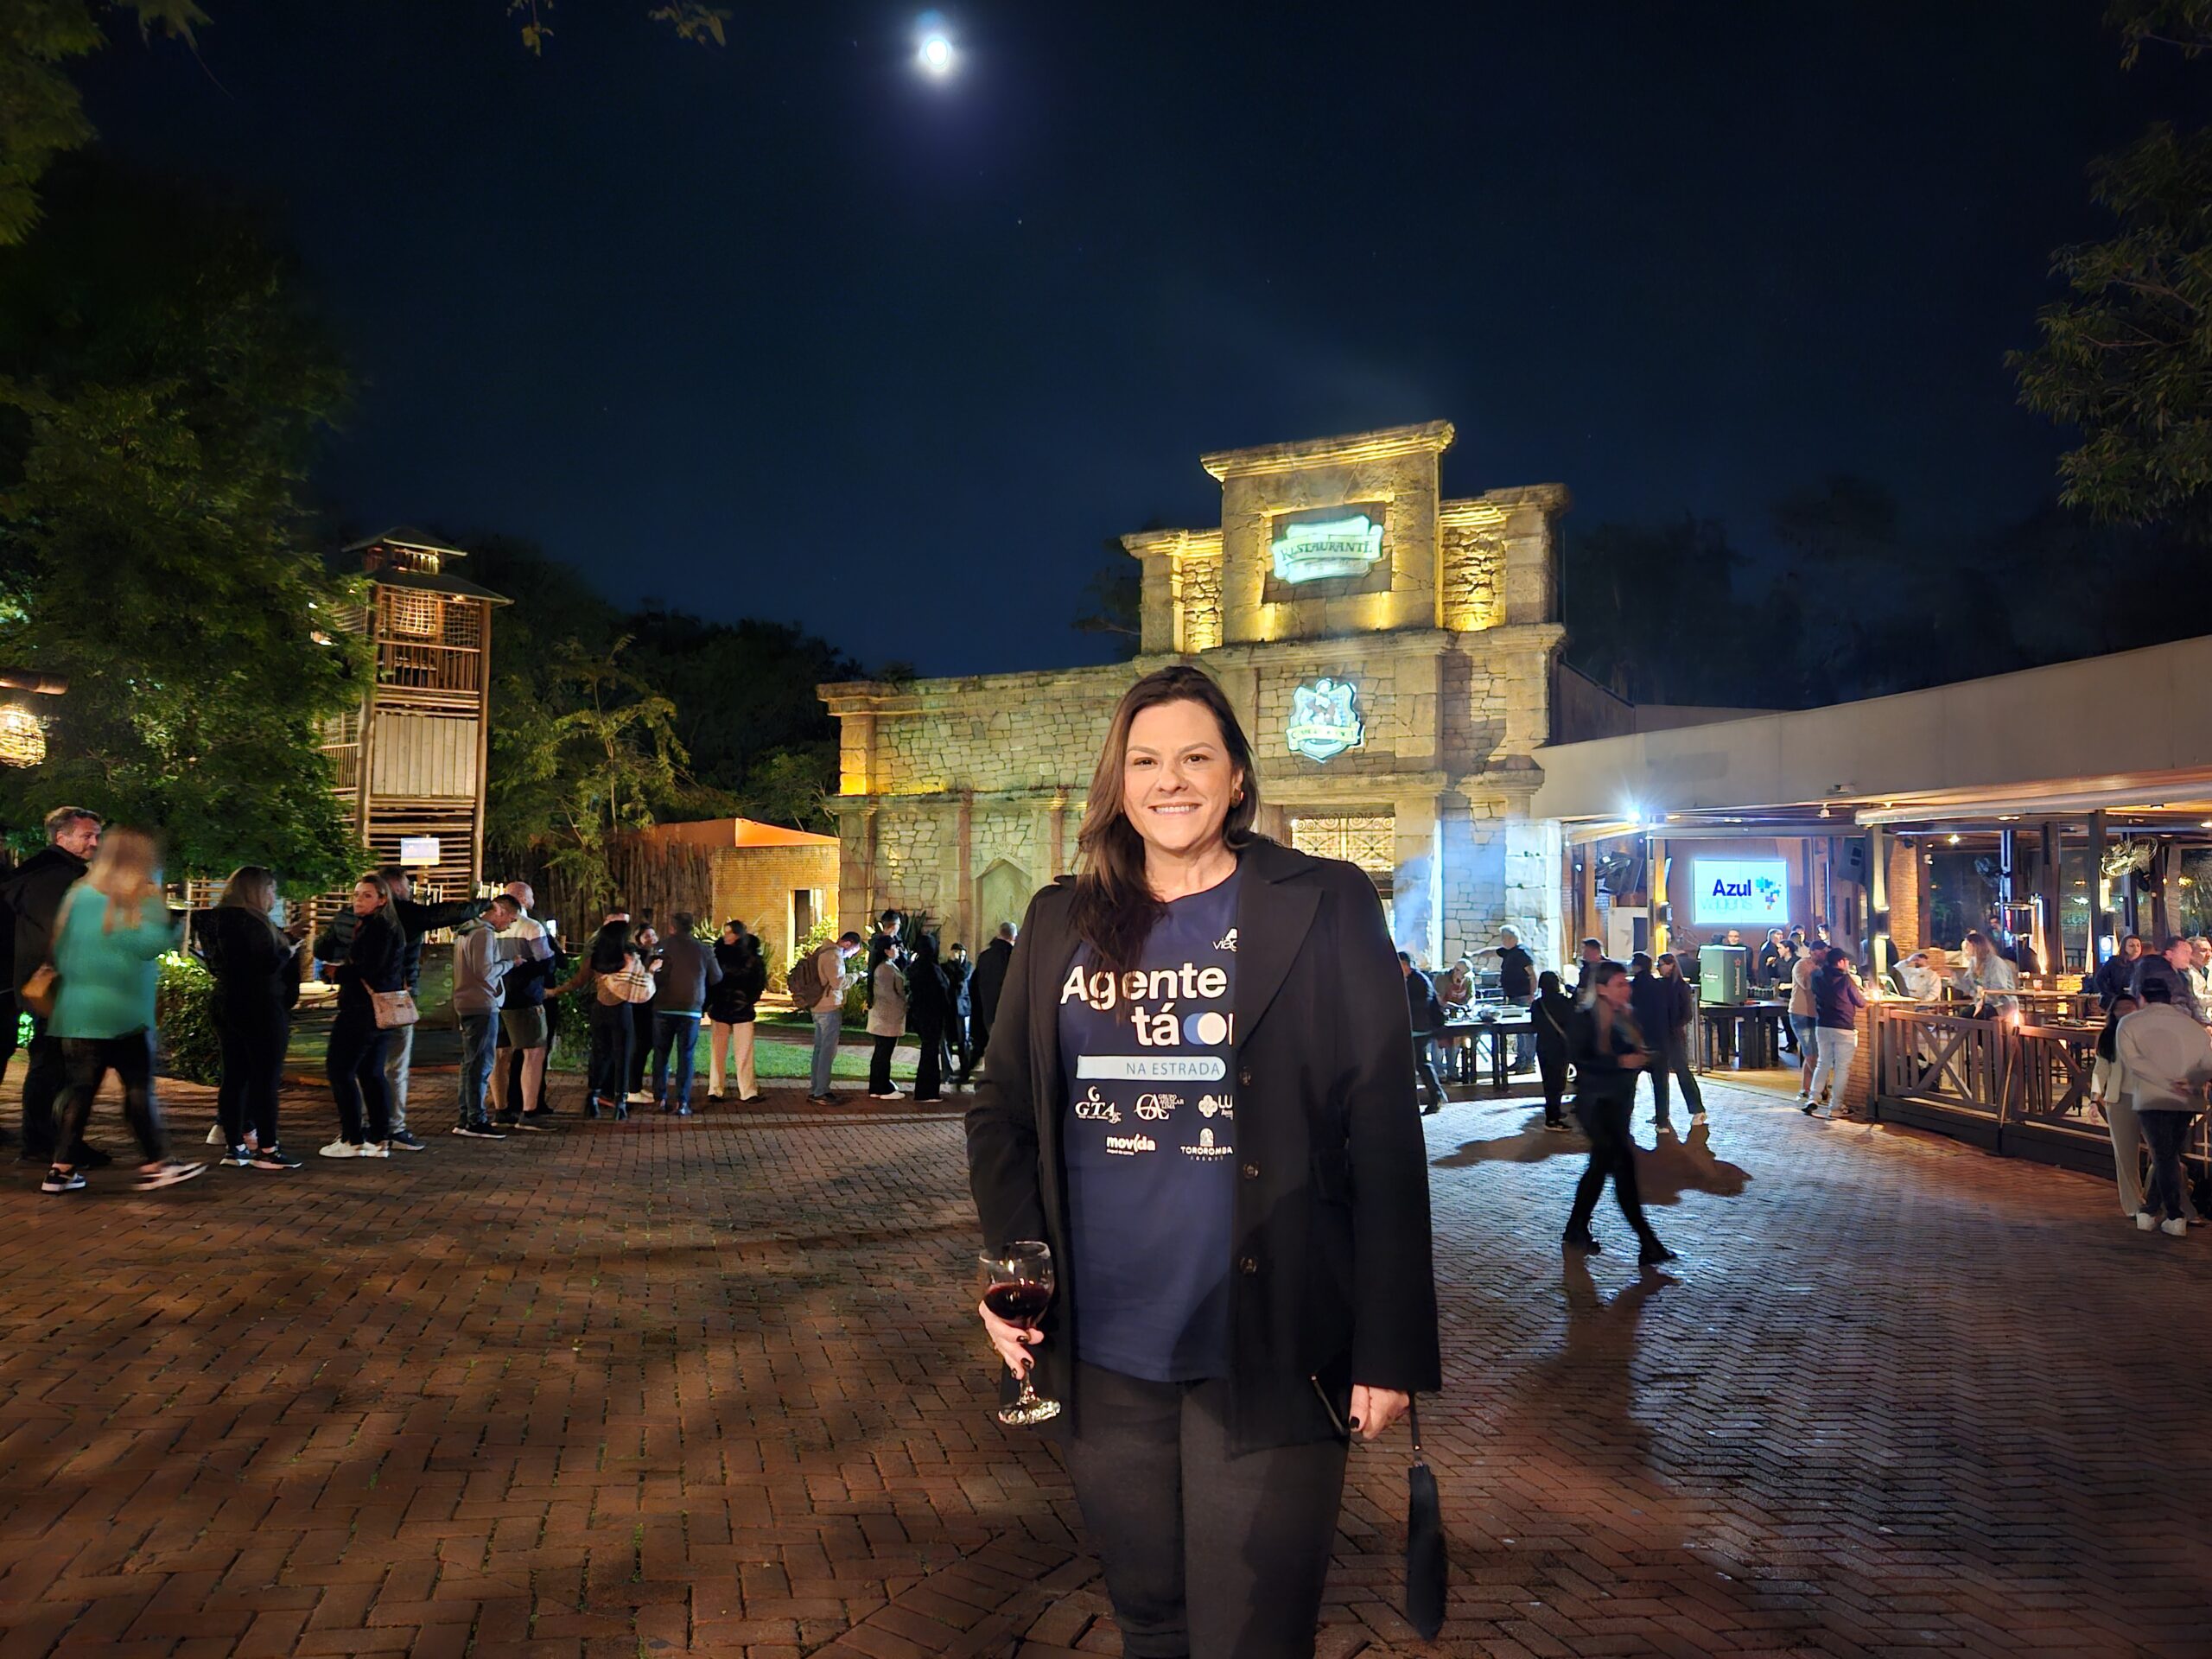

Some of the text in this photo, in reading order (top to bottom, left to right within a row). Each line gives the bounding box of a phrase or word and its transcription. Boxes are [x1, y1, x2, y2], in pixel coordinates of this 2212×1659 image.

[1713, 879, 1751, 897] Azul
[1060, 963, 1227, 1011] Agente
[1131, 1002, 1180, 1046] tá
[1126, 1061, 1220, 1076] NA ESTRADA
[1075, 1101, 1116, 1116] GTA
[1106, 1133, 1155, 1153] movida
[1180, 1146, 1234, 1156] TOROROMBA
